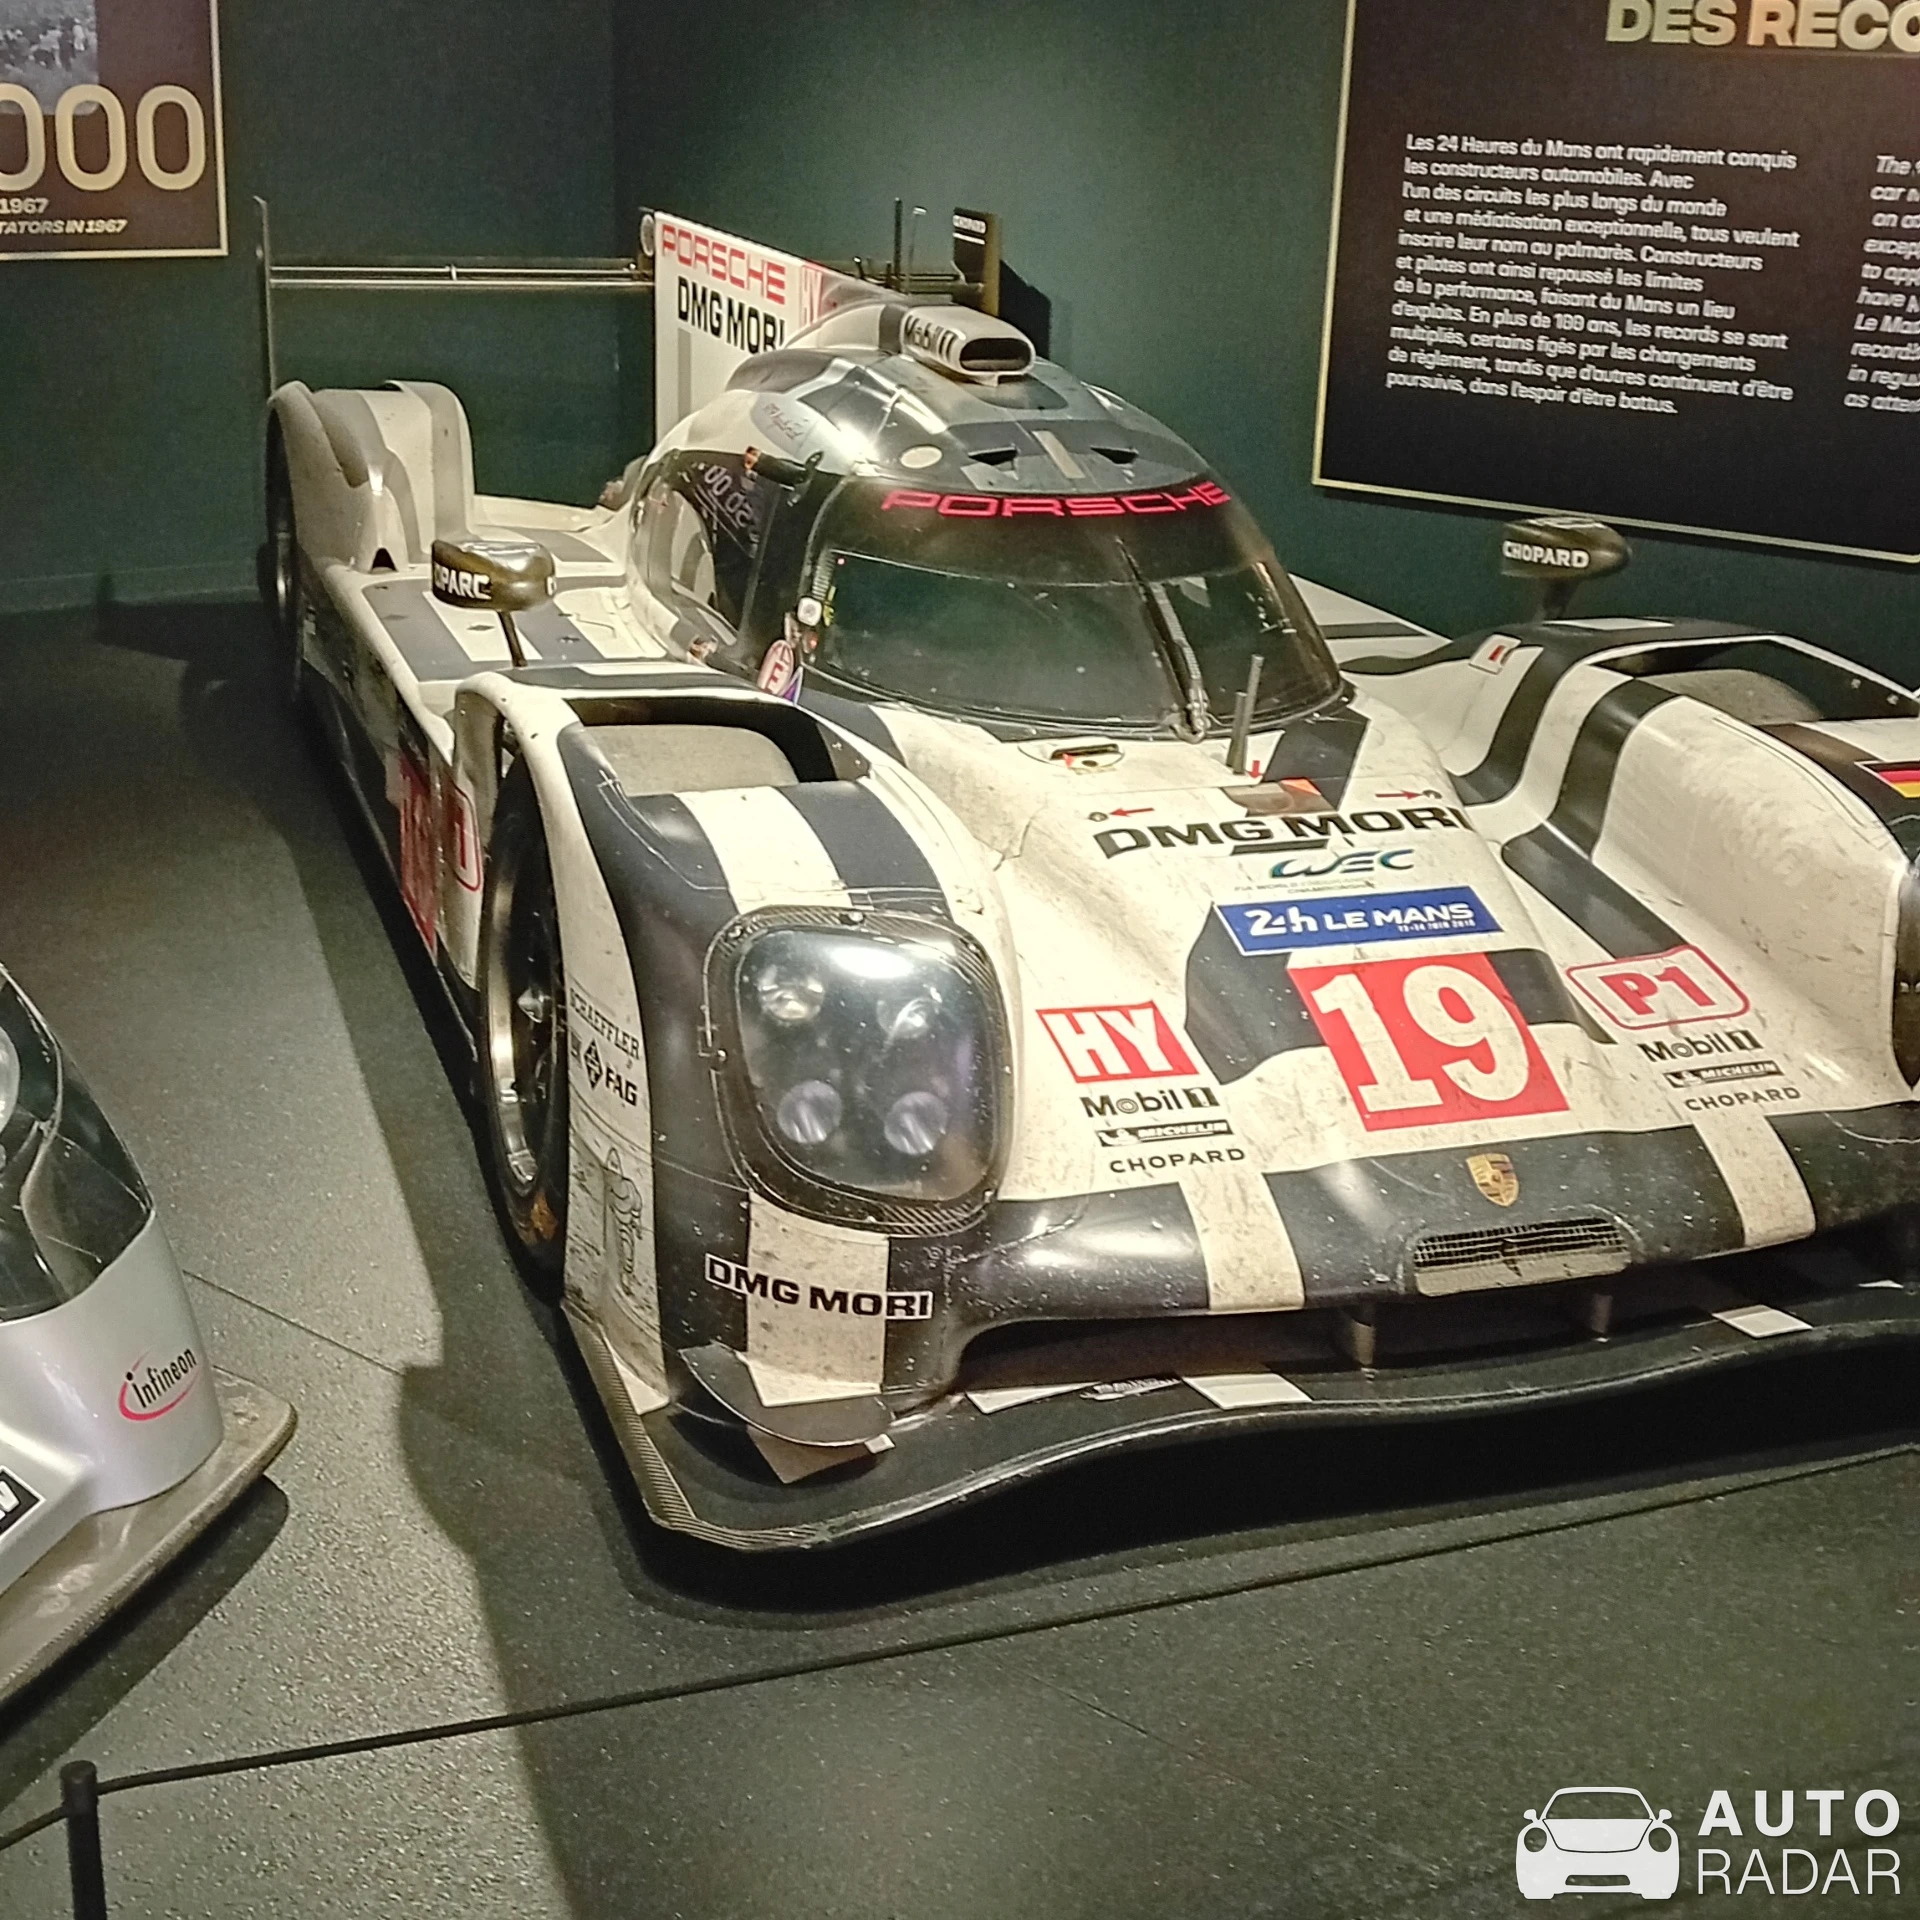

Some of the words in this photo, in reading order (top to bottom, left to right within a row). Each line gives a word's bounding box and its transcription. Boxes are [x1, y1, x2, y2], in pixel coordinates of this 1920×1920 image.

[1605, 0, 1737, 46] DES
[1406, 134, 1435, 151] Les
[1437, 135, 1459, 152] 24
[1461, 136, 1518, 155] Heures
[1521, 138, 1543, 157] du
[1545, 140, 1592, 158] Mans
[1594, 145, 1624, 160] ont
[1626, 144, 1725, 166] rapidement
[1727, 150, 1797, 172] conquis
[1877, 155, 1911, 174] The
[1404, 157, 1428, 175] les
[1430, 162, 1539, 181] constructeurs
[1541, 166, 1647, 187] automobiles.
[1649, 170, 1695, 189] Avec
[1402, 181, 1430, 199] l'un
[1433, 182, 1462, 201] des
[1464, 185, 1523, 205] circuits
[1525, 187, 1550, 207] les
[1552, 189, 1589, 212] plus
[1591, 191, 1638, 215] longs
[1640, 194, 1664, 213] du
[1666, 198, 1727, 217] monde
[1870, 186, 1906, 201] car
[66, 220, 85, 233] IN
[85, 219, 128, 233] 1967
[1403, 207, 1421, 223] et
[1423, 210, 1454, 225] une
[1455, 210, 1562, 232] médiatisation
[1564, 217, 1687, 242] exceptionnelle,
[1690, 225, 1730, 243] tous
[1732, 227, 1801, 248] veulent
[662, 223, 786, 305] PORSCHE
[1398, 229, 1456, 248] inscrire
[1457, 232, 1490, 250] leur
[1491, 238, 1528, 254] nom
[1530, 240, 1552, 255] au
[1554, 240, 1638, 262] palmarès.
[1640, 245, 1763, 271] Constructeurs
[1395, 255, 1413, 269] et
[1415, 254, 1466, 274] pilotes
[1468, 261, 1495, 276] ont
[1498, 260, 1536, 279] ainsi
[1538, 266, 1614, 285] repoussé
[1616, 268, 1642, 287] les
[1645, 270, 1703, 292] limites
[678, 275, 723, 339] DMG
[726, 296, 786, 355] MORI
[1394, 276, 1414, 294] de
[1416, 278, 1432, 294] la
[1434, 281, 1537, 306] performance,
[1540, 287, 1598, 308] faisant
[1599, 292, 1621, 310] du
[1624, 294, 1673, 315] Mans
[1676, 301, 1699, 317] un
[1702, 299, 1735, 319] lieu
[1857, 286, 1906, 307] have
[1391, 299, 1466, 322] d'exploits.
[1469, 305, 1490, 323] En
[1492, 307, 1527, 328] plus
[1529, 311, 1551, 328] de
[1587, 318, 1622, 337] ans,
[1625, 318, 1651, 337] les
[1654, 325, 1719, 344] records
[1722, 331, 1744, 346] se
[1747, 333, 1789, 350] sont
[1854, 313, 1878, 331] Le
[1469, 333, 1534, 351] certains
[1536, 335, 1576, 357] figés
[1578, 344, 1609, 360] par
[1610, 342, 1637, 360] les
[1638, 345, 1756, 372] changements
[1387, 346, 1408, 363] de
[1410, 349, 1492, 374] règlement,
[1494, 358, 1544, 377] tandis
[1545, 365, 1577, 382] que
[1579, 364, 1646, 387] d'autres
[1648, 374, 1740, 396] continuent
[1741, 379, 1794, 401] d'être
[1847, 363, 1868, 381] in
[1385, 371, 1467, 395] poursuivis,
[1469, 377, 1508, 397] dans
[1511, 381, 1568, 404] l'espoir
[1569, 387, 1616, 408] d'être
[1618, 391, 1679, 414] battus.
[881, 480, 1231, 518] PORSCHE
[1502, 540, 1590, 569] CHOPARD
[1093, 820, 1272, 859] DMG
[1280, 806, 1474, 839] MORI
[1269, 849, 1414, 879] WEC
[1243, 905, 1319, 937] 24h
[1322, 911, 1369, 931] LE
[1372, 902, 1474, 927] MANS
[1599, 966, 1716, 1015] P1
[1050, 1007, 1174, 1077] HY
[1310, 964, 1530, 1114] 19
[1637, 1032, 1732, 1063] Mobil
[605, 1066, 637, 1107] FAG
[1700, 1063, 1777, 1079] MICHELIN
[1080, 1089, 1183, 1118] Mobil
[1685, 1086, 1801, 1111] CHOPARD
[1138, 1122, 1228, 1138] MICHELIN
[1110, 1148, 1245, 1173] CHOPARD
[709, 1259, 799, 1305] DMG
[809, 1286, 929, 1317] MORI
